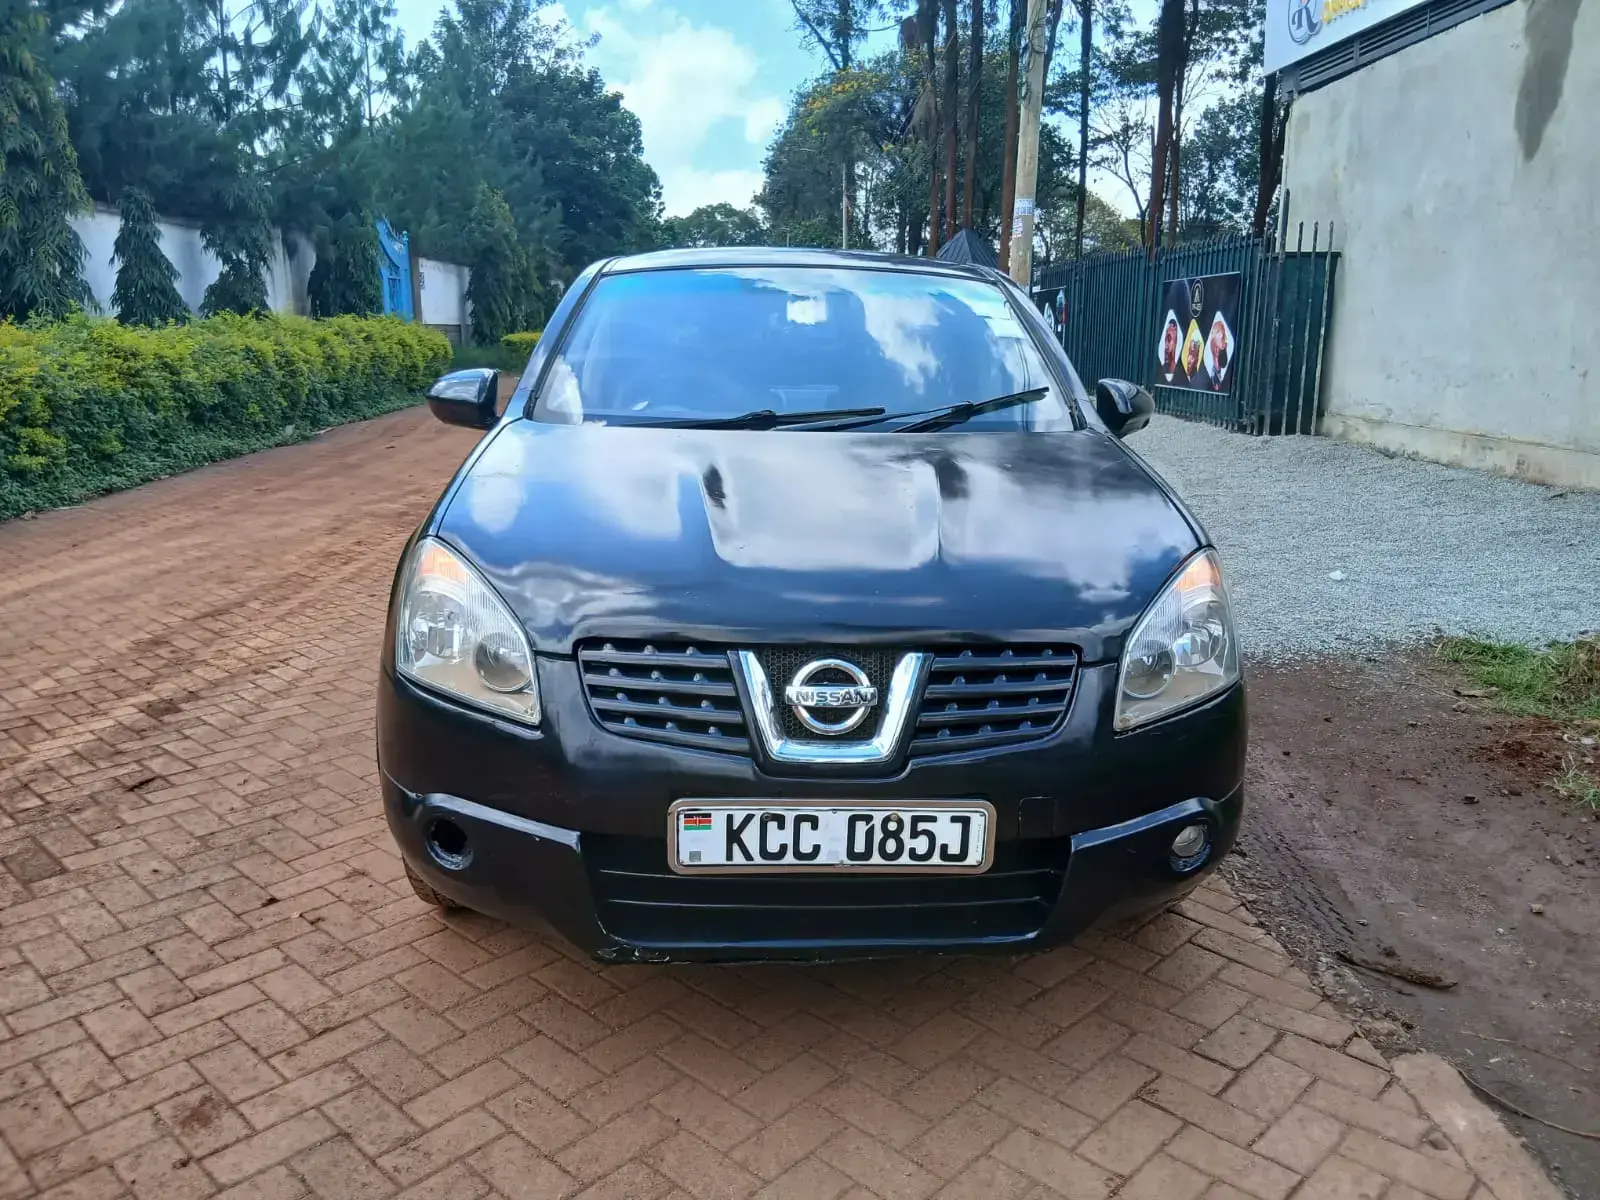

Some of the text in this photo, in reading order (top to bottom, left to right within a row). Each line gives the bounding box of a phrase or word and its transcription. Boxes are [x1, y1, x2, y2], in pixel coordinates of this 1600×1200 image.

[796, 691, 870, 703] NISSAN
[726, 813, 821, 861] KCC
[846, 813, 970, 862] 085J
